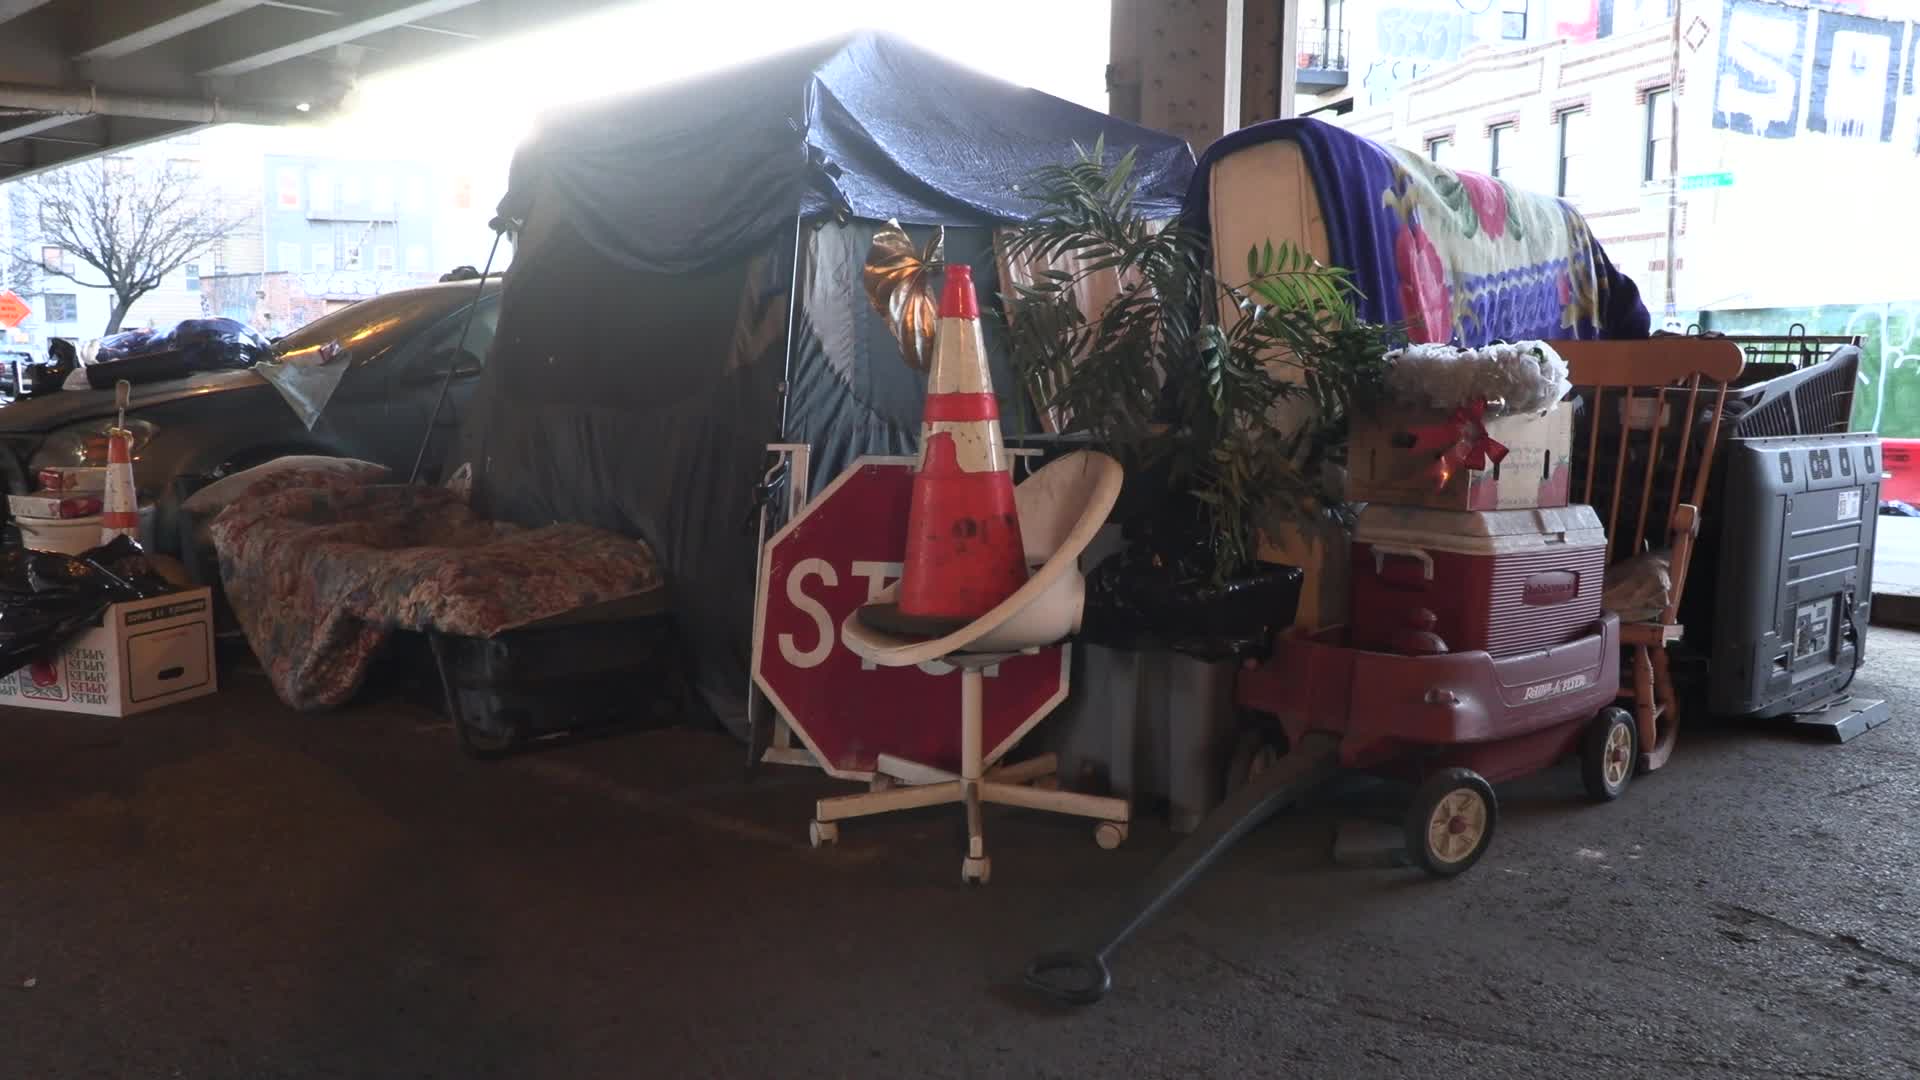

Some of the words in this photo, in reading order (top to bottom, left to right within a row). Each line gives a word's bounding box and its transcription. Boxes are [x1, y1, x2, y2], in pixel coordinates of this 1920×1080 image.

[69, 670, 106, 682] APPLES
[70, 681, 107, 694] APPLES
[71, 692, 109, 705] APPLES
